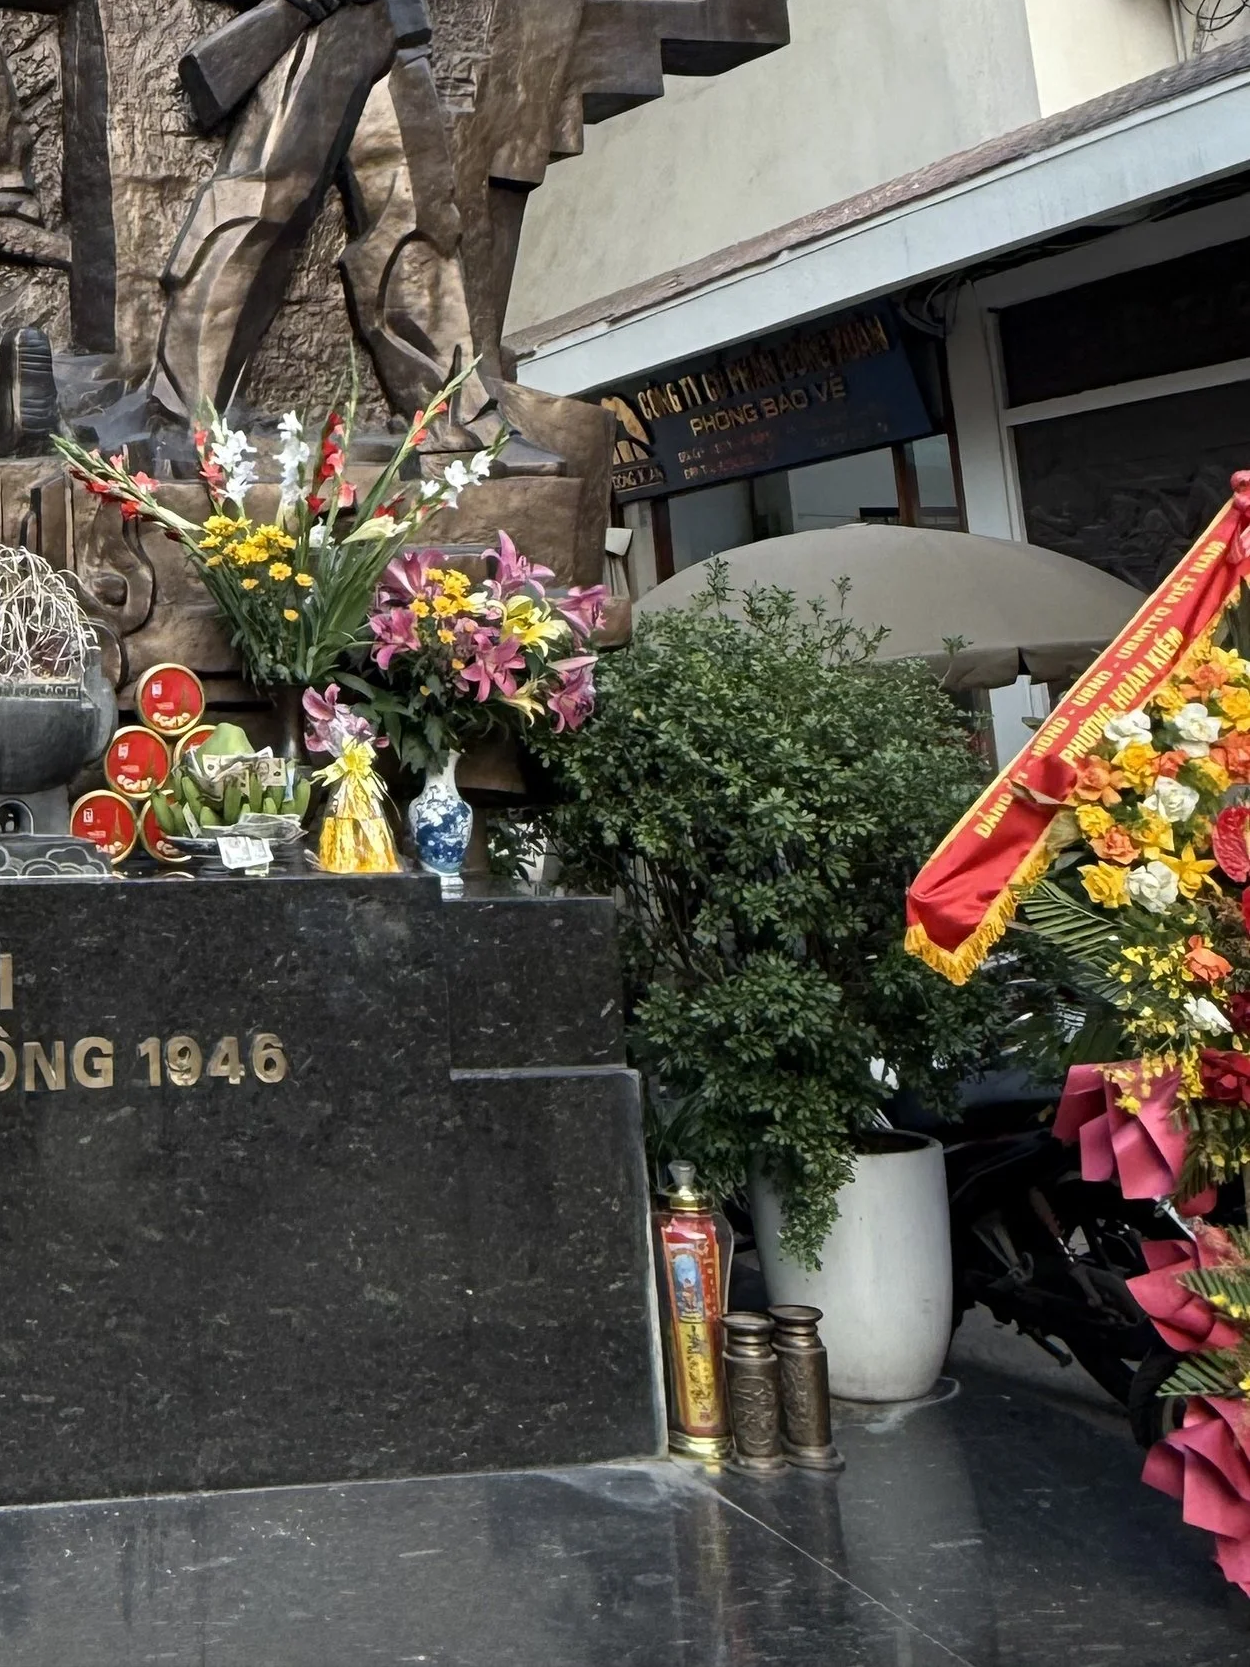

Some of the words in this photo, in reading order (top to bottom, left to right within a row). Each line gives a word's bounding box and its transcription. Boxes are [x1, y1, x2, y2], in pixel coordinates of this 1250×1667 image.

[1163, 577, 1197, 605] VIỆT
[1188, 540, 1227, 574] NAM
[1058, 702, 1117, 769] PHƯỜNG
[1108, 662, 1156, 709] HOÀN
[1144, 626, 1184, 671] KIẾM
[138, 1032, 289, 1088] 1946
